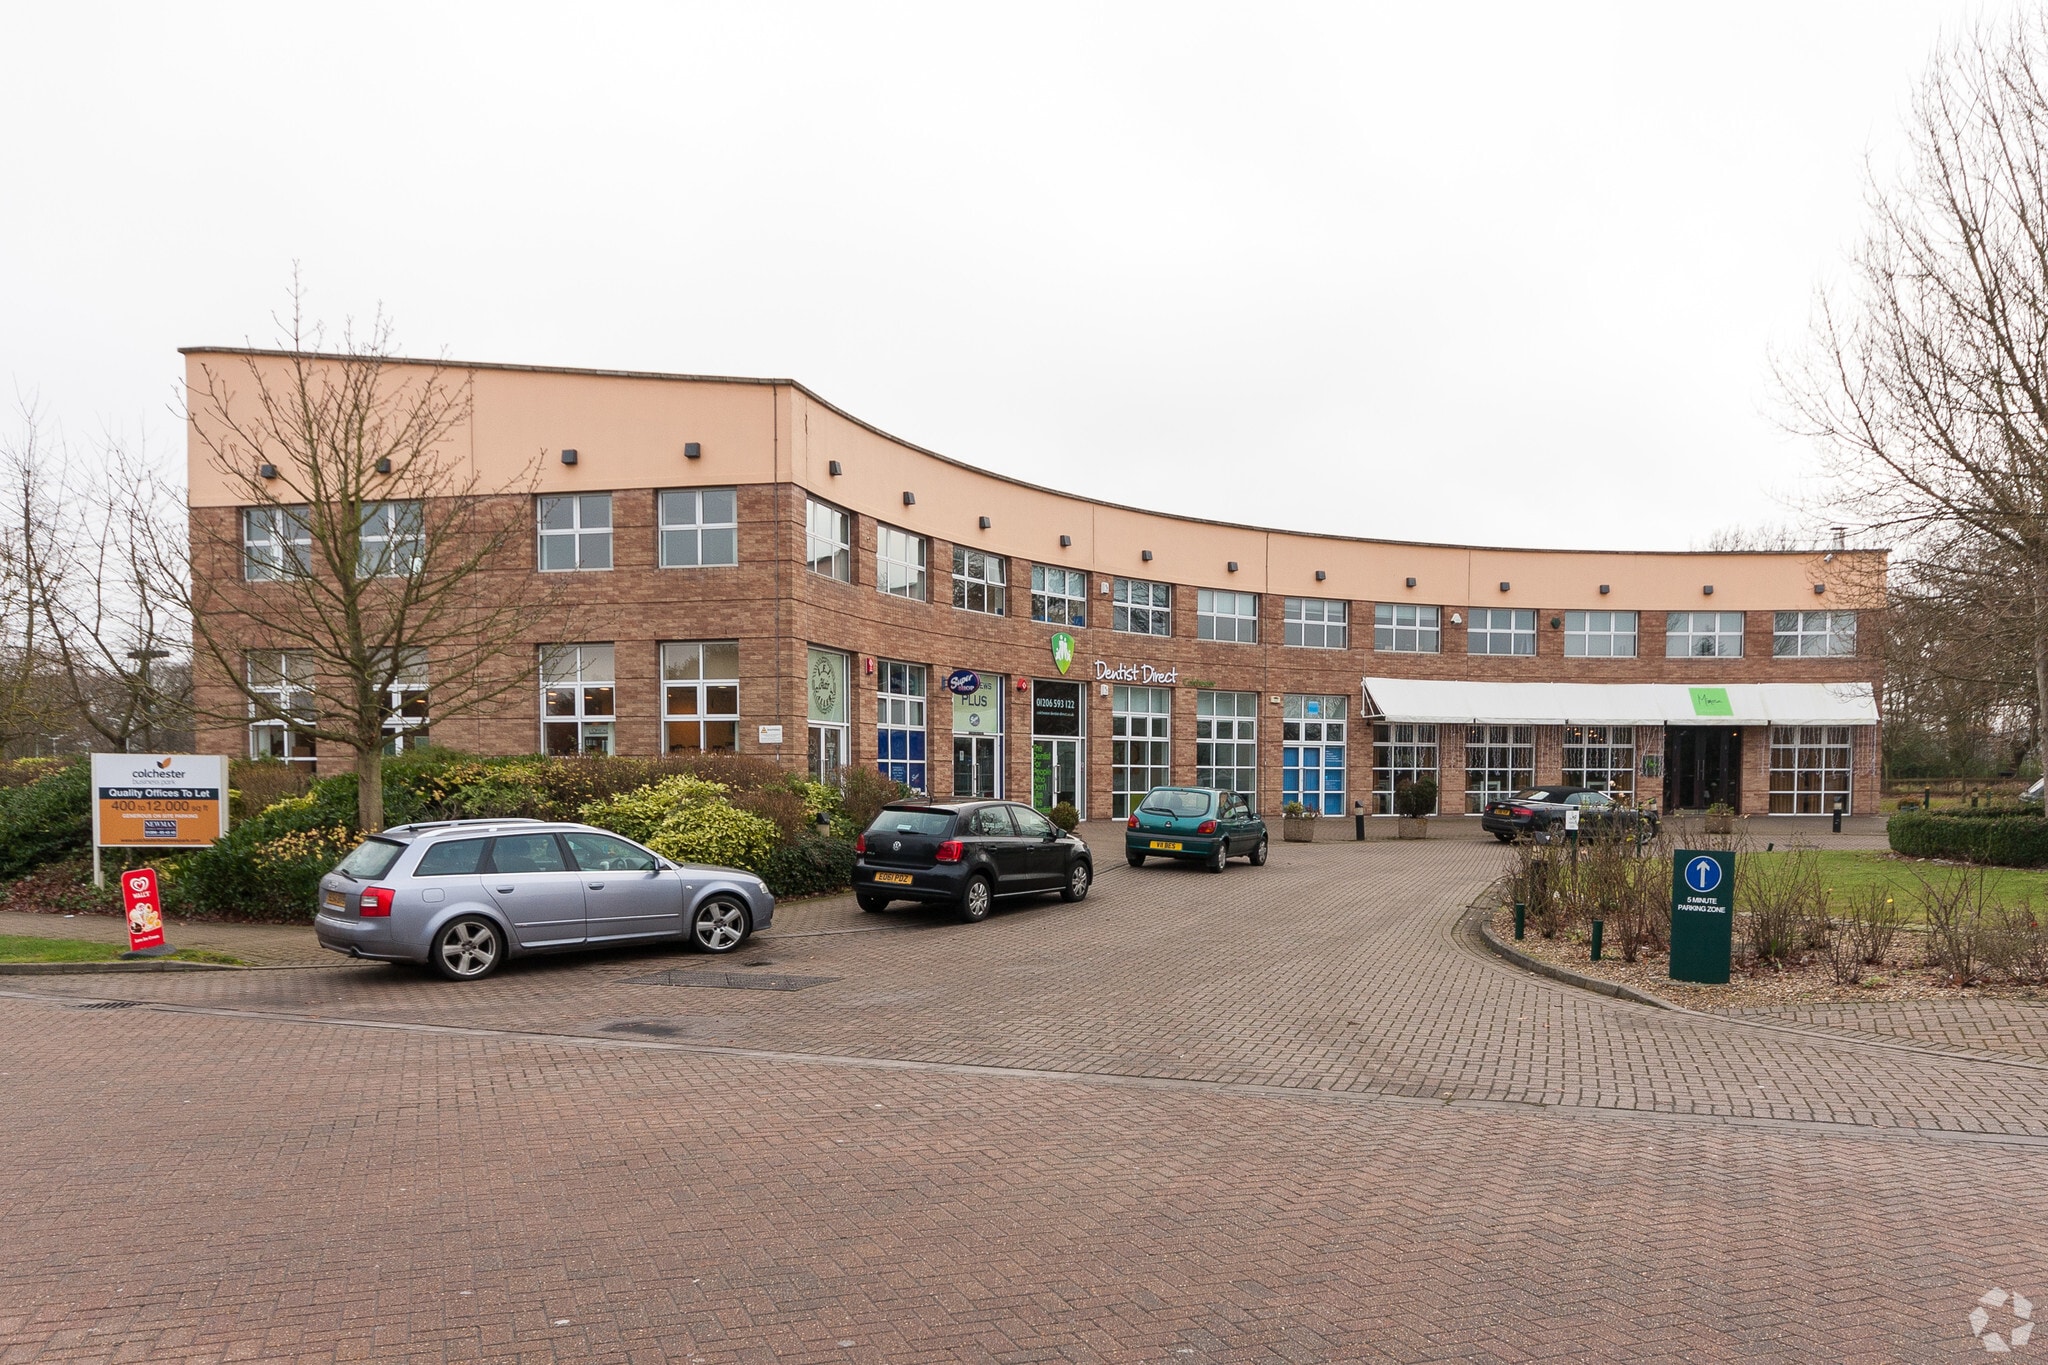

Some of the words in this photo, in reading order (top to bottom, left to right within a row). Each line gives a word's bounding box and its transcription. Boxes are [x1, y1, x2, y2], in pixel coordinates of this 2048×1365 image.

[1095, 660, 1139, 681] Dentist
[1141, 664, 1178, 684] Direct
[950, 674, 973, 690] Super
[961, 694, 988, 707] PLUS
[1036, 698, 1053, 708] 01206
[1053, 699, 1065, 708] 593
[1065, 700, 1075, 709] 122
[132, 769, 187, 779] colchester
[108, 788, 143, 798] Quality
[145, 788, 180, 797] Offices
[181, 789, 192, 797] To
[194, 789, 210, 798] Let
[111, 801, 135, 811] 400
[1692, 897, 1717, 905] MINUTE
[1678, 904, 1706, 912] PARKING
[1706, 906, 1726, 914] ZONE
